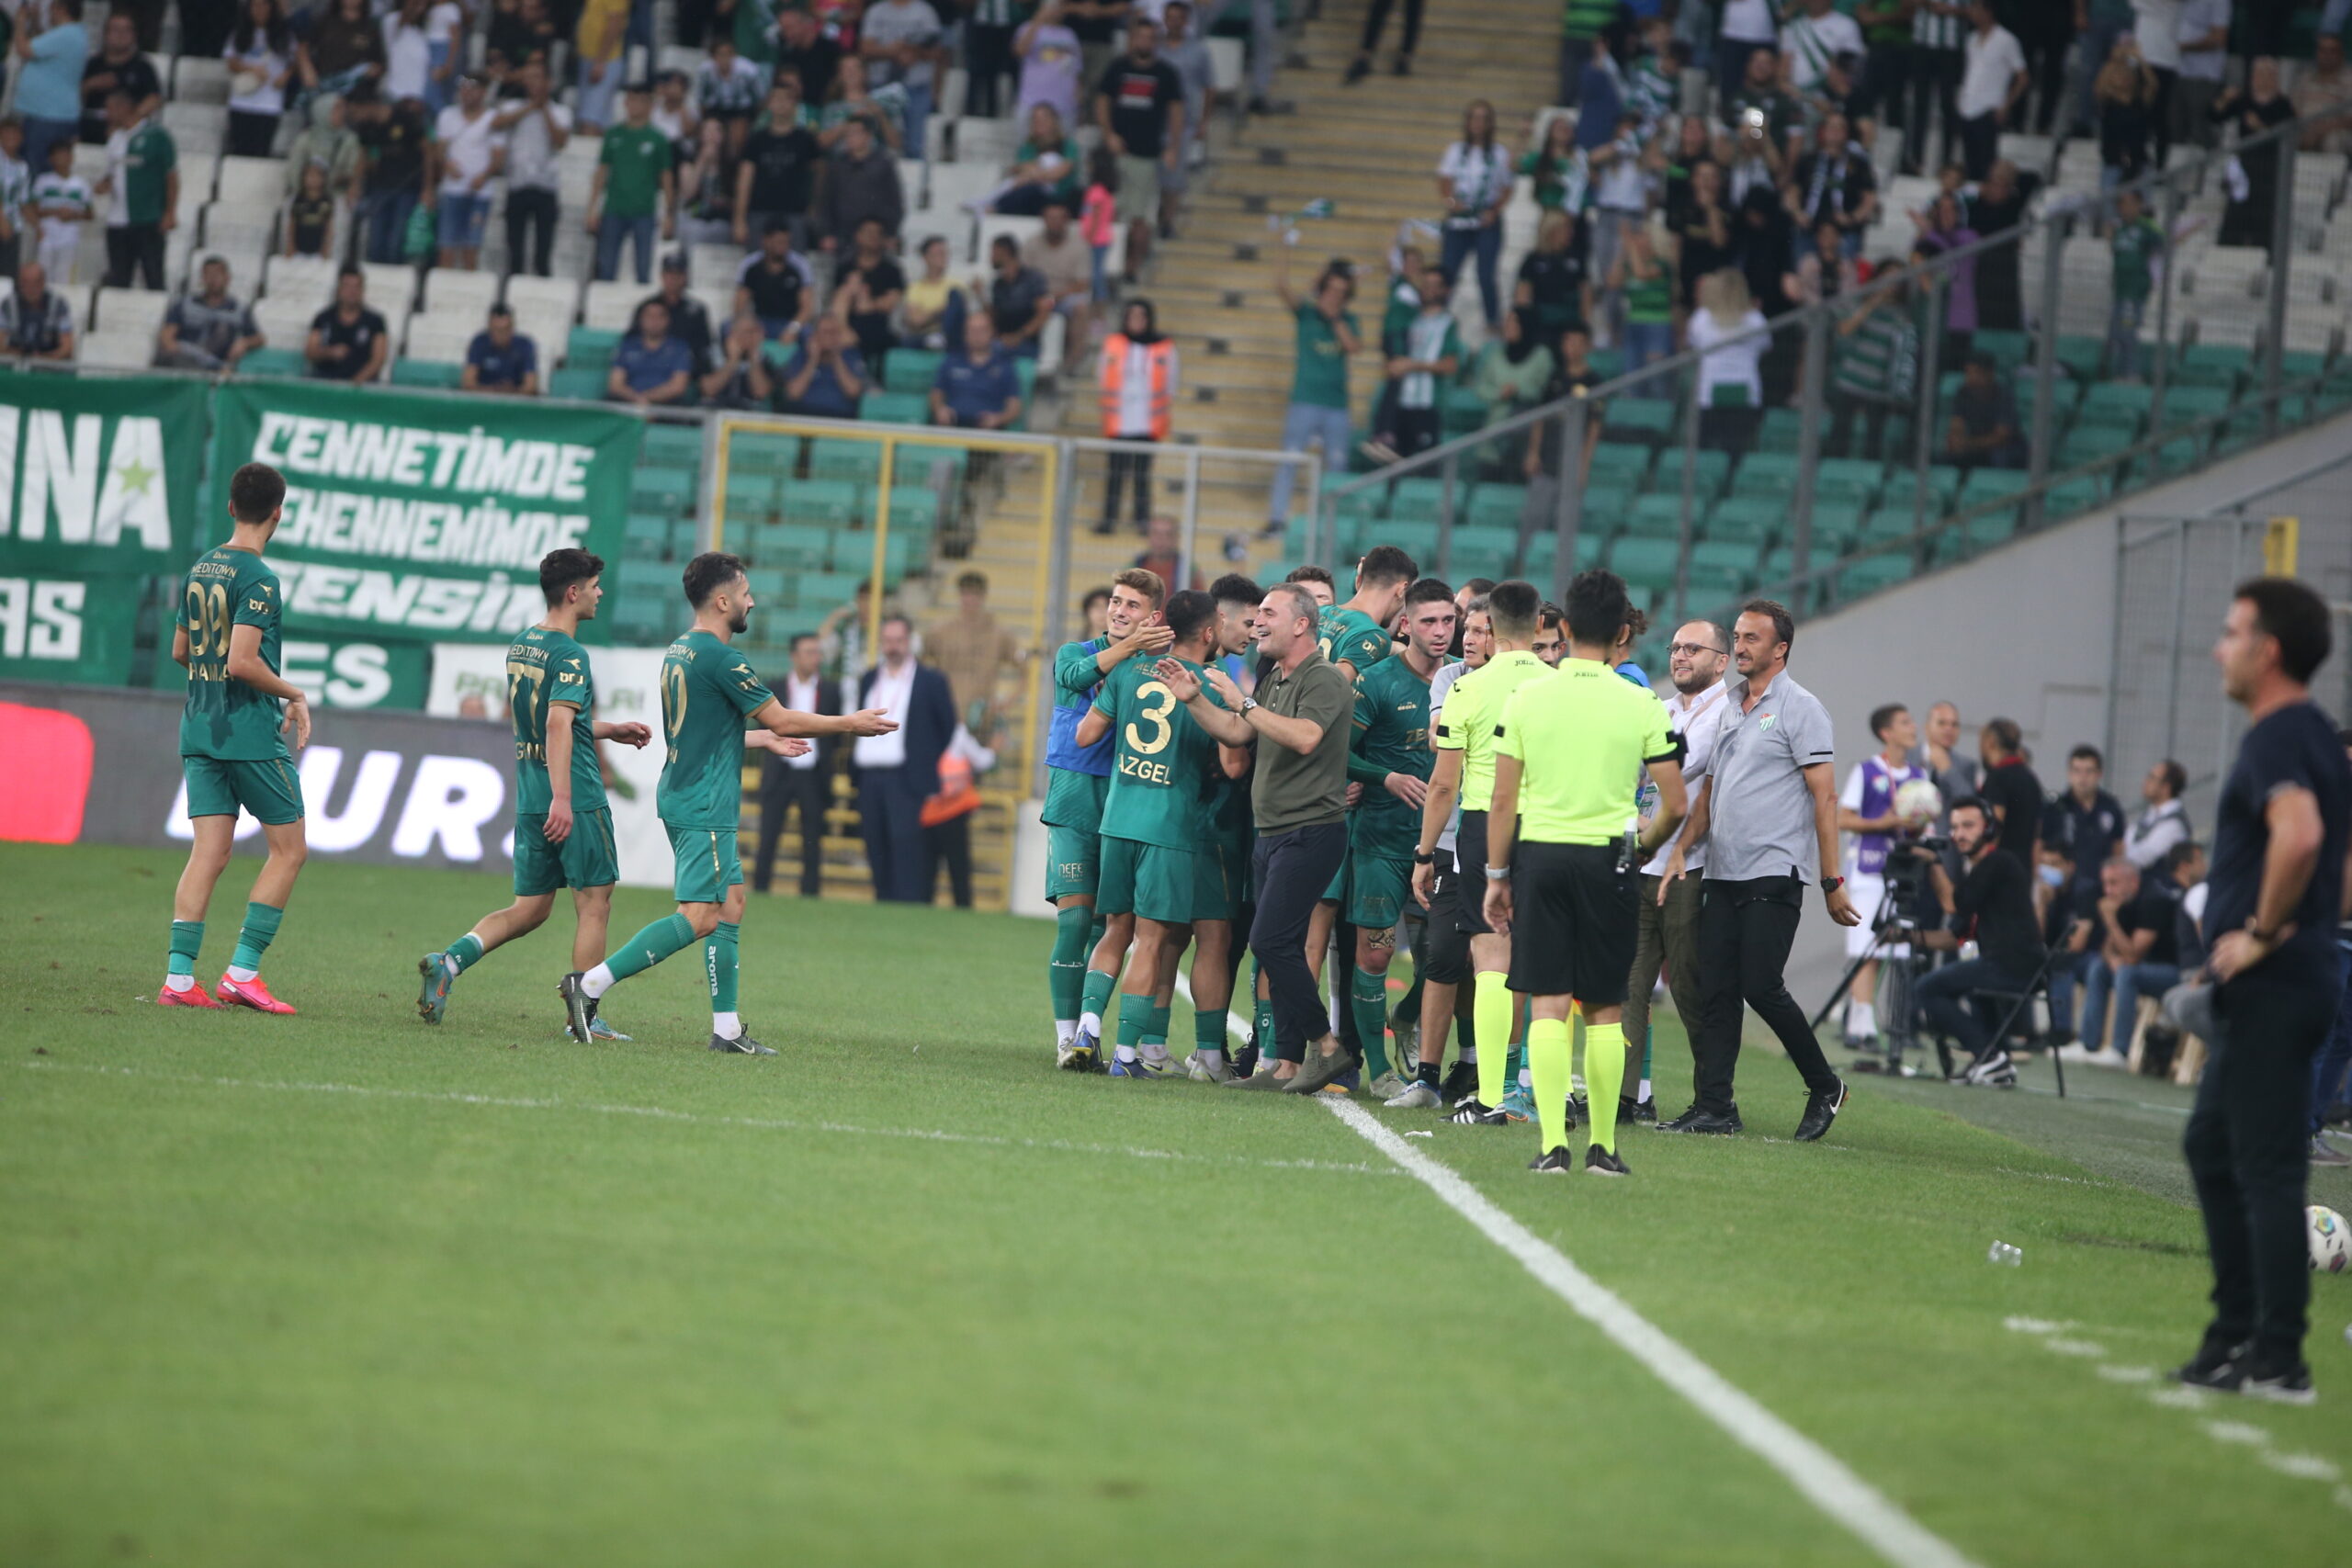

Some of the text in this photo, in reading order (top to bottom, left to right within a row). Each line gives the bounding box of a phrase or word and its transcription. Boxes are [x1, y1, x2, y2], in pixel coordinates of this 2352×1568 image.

[187, 581, 231, 658] 99
[506, 661, 546, 739] 77
[1125, 681, 1177, 755] 3
[708, 945, 718, 998] aroma
